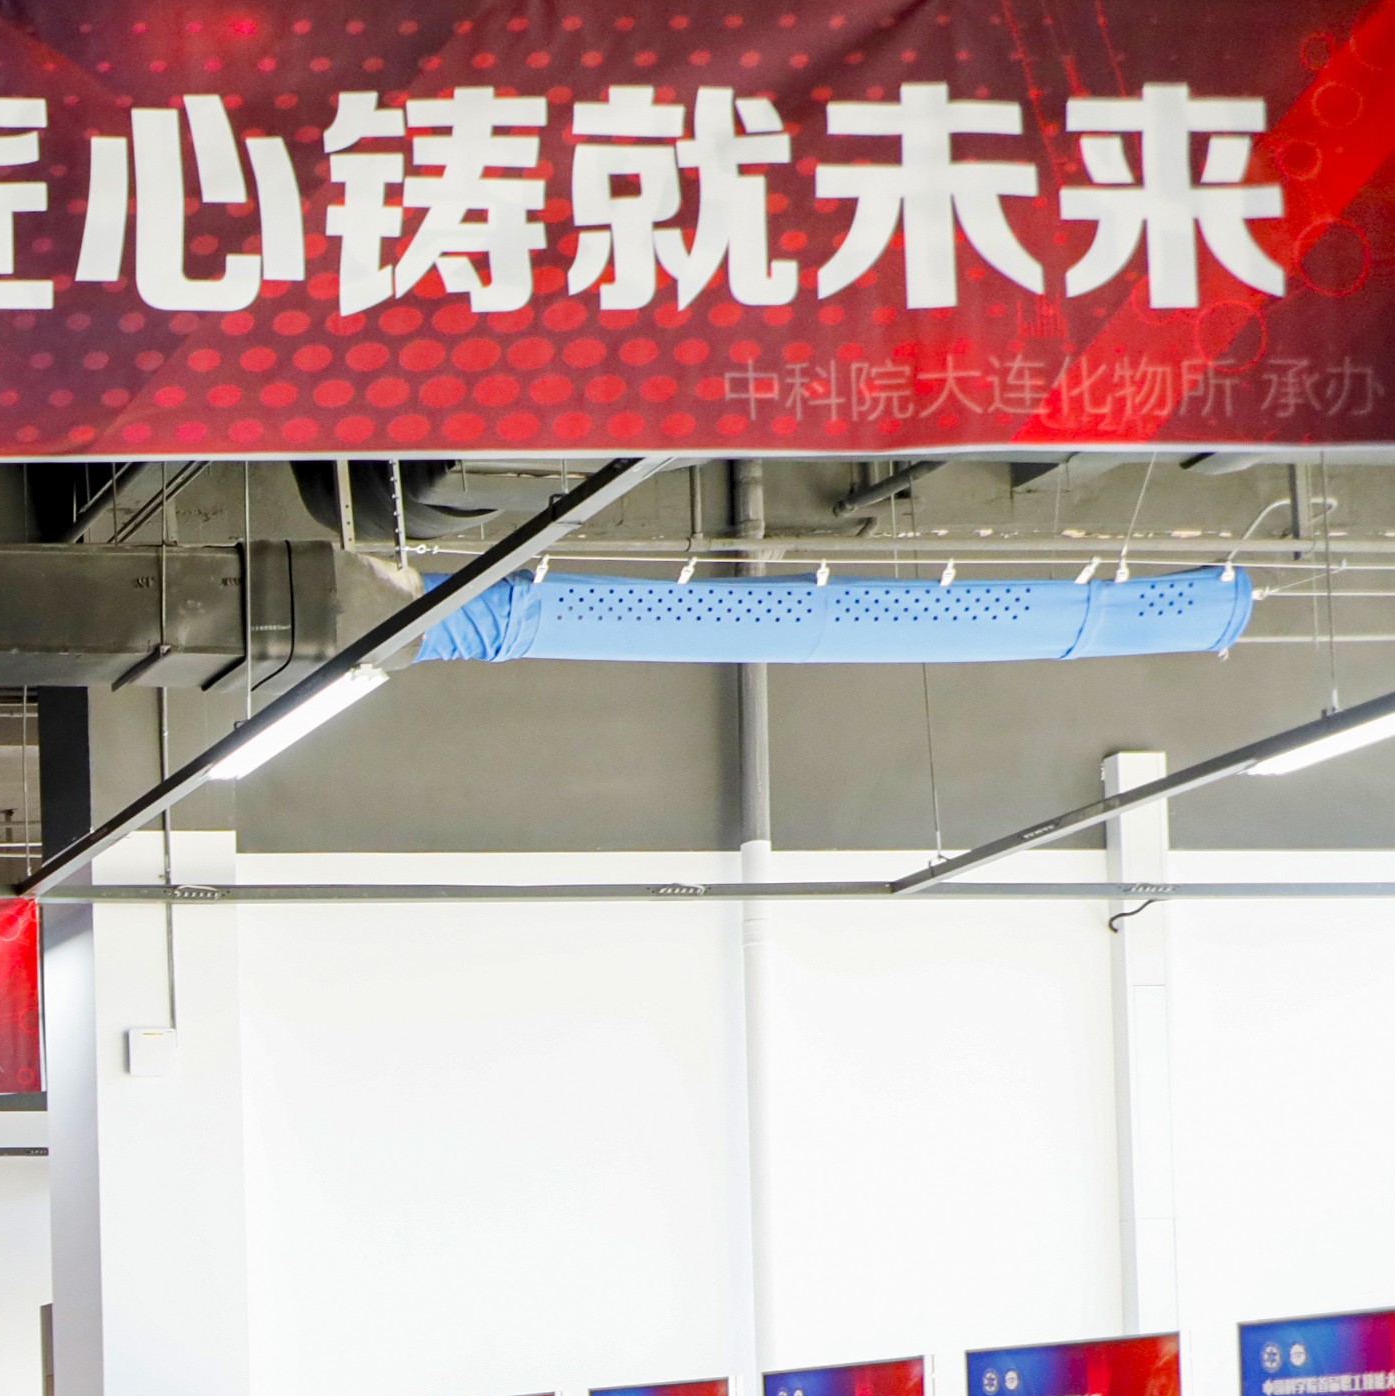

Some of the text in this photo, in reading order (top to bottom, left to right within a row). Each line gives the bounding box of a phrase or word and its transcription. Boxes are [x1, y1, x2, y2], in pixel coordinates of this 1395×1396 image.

[723, 355, 1386, 421] 中科院大连化物所 承办
